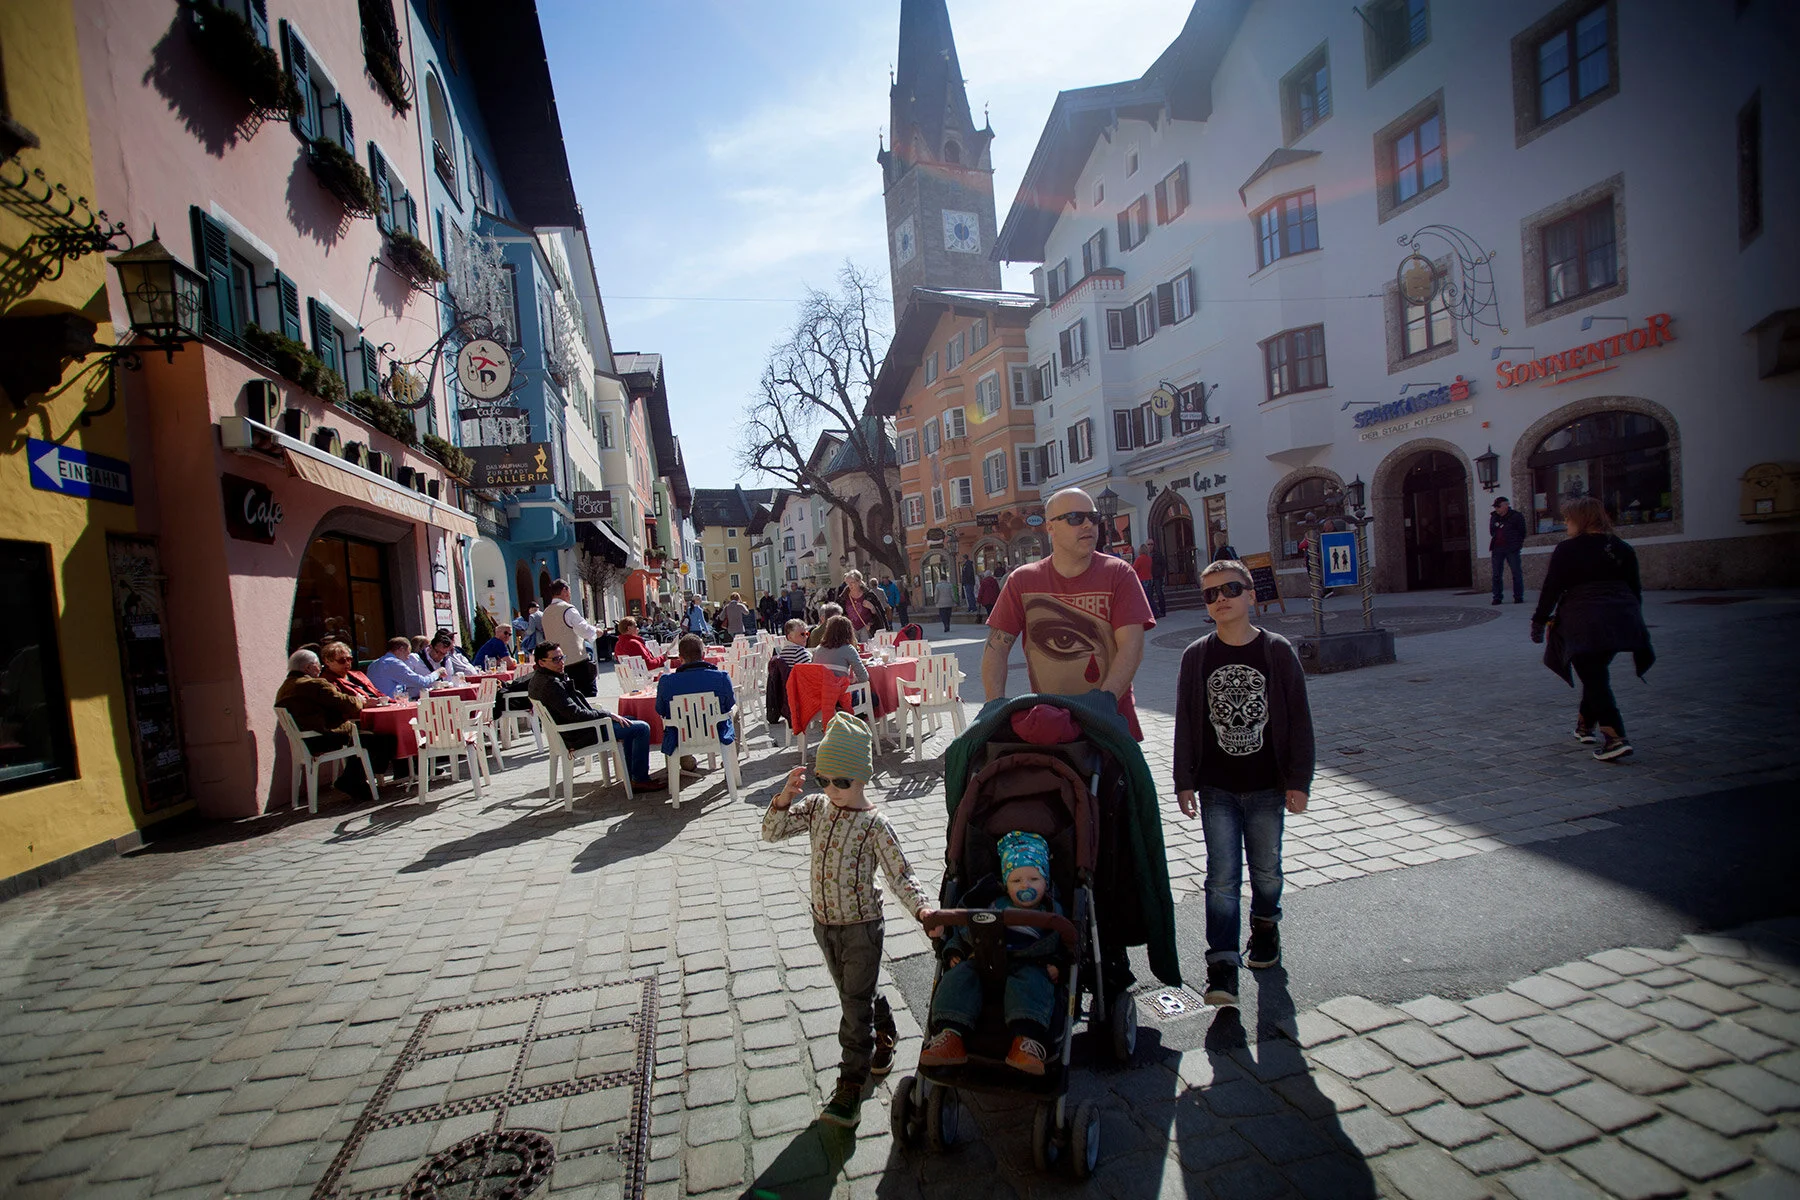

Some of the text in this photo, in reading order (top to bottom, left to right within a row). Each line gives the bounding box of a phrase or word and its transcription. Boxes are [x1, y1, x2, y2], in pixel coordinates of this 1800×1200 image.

[1496, 313, 1677, 389] SONNENTOR
[1353, 385, 1452, 429] SPARKASSE
[1361, 430, 1379, 441] DER
[1382, 422, 1410, 436] STADT
[58, 460, 120, 489] EINBAHN
[487, 473, 549, 485] GALLERIA
